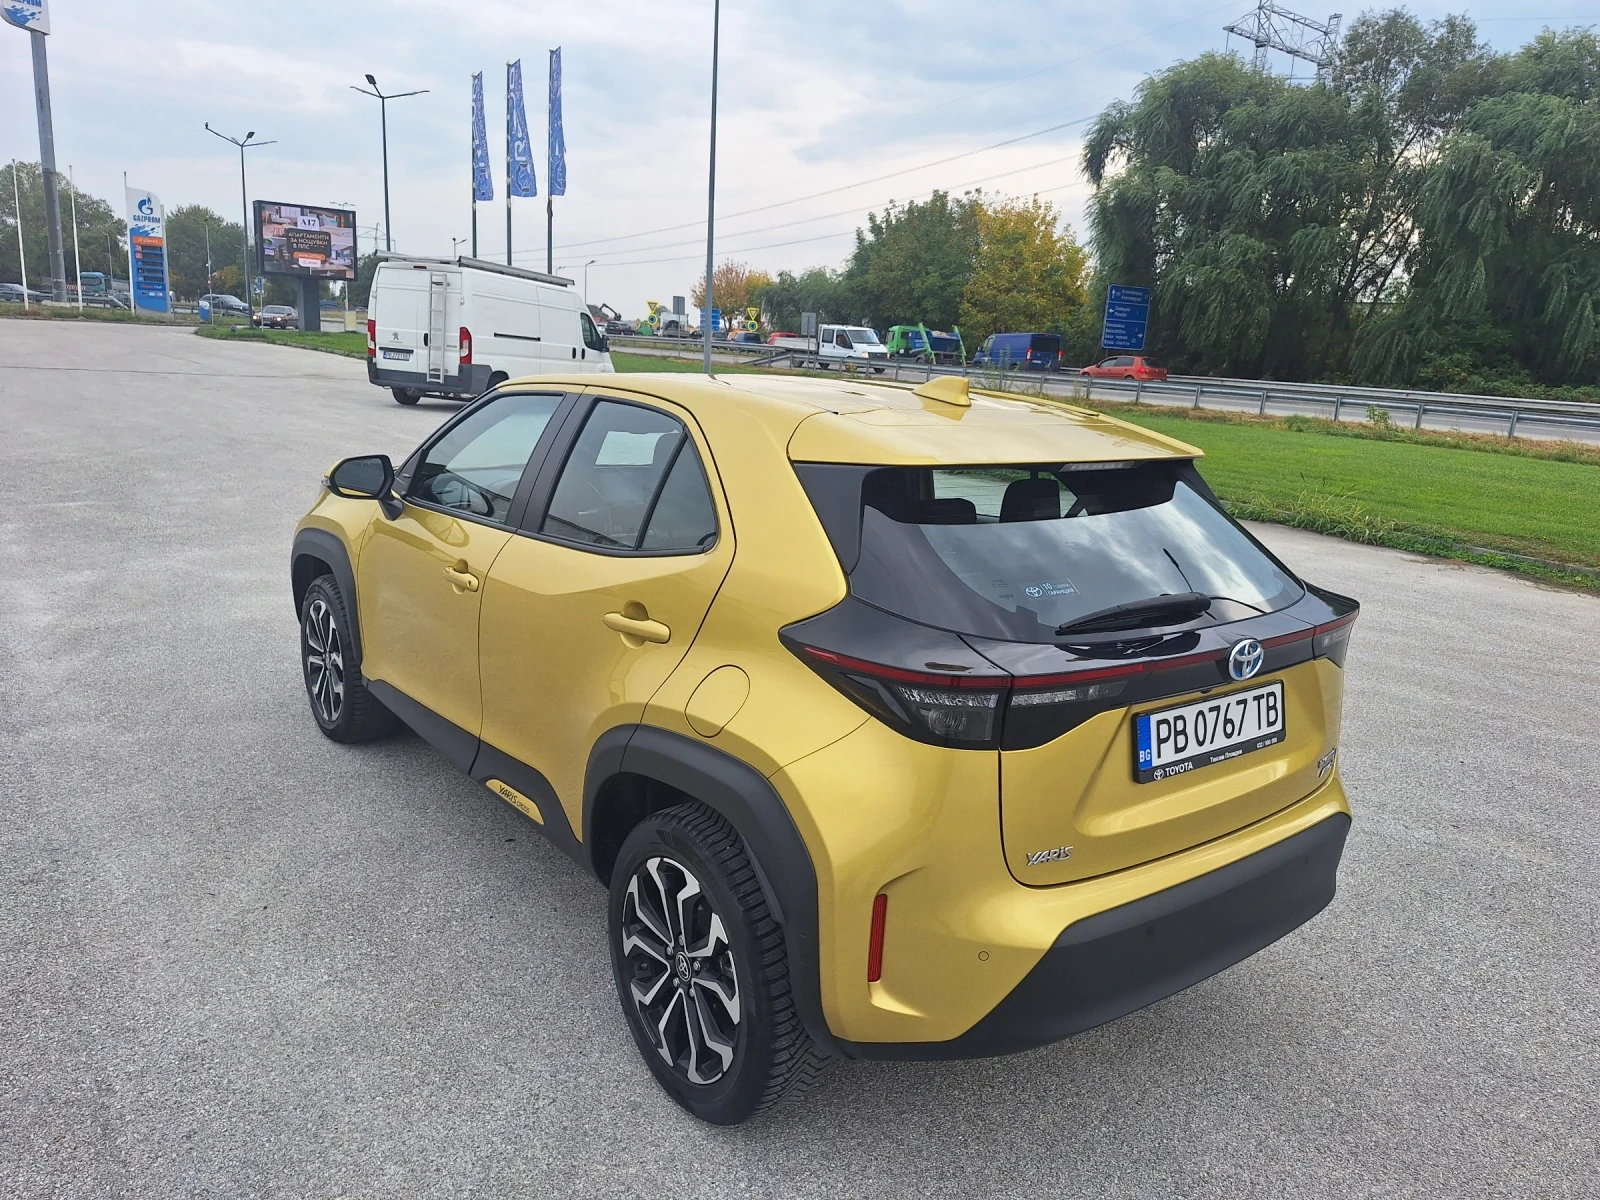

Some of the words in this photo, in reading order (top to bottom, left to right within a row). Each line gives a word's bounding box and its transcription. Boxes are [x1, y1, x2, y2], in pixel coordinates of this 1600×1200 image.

[133, 215, 160, 223] GAZPROM
[288, 232, 329, 240] АПАРТАМЕНТИ
[298, 238, 328, 246] НОЩУВКИ
[1042, 582, 1053, 590] 10
[1156, 714, 1189, 759] PB
[1194, 698, 1248, 747] 0767
[1252, 691, 1279, 731] TB
[1139, 749, 1151, 763] BG
[1165, 761, 1194, 777] TOYOTA
[499, 784, 518, 804] YARIS
[1026, 845, 1074, 866] YARIS
